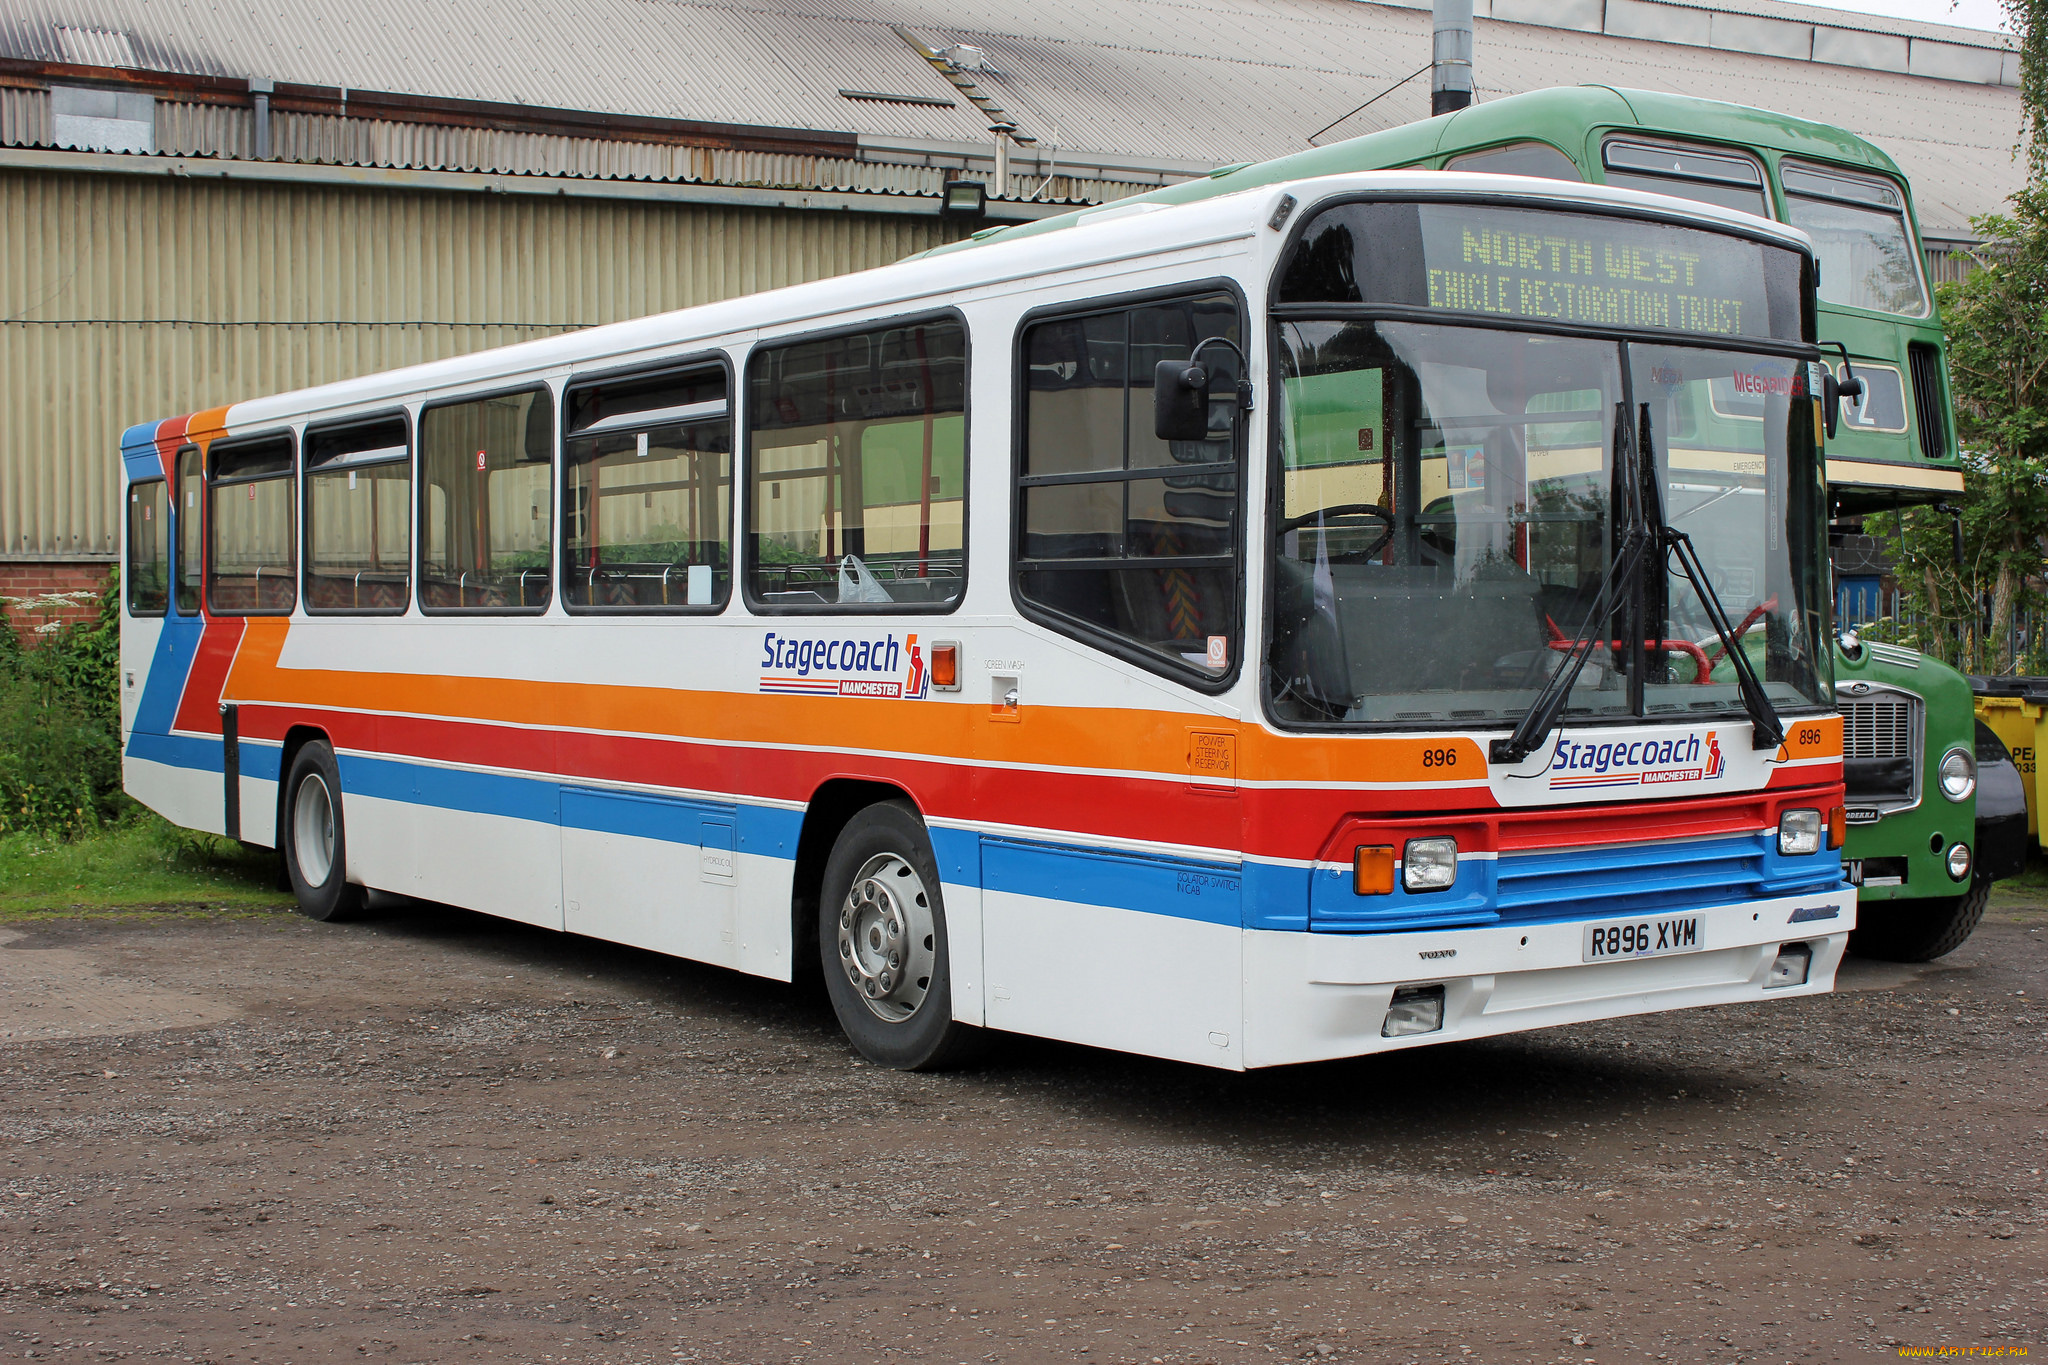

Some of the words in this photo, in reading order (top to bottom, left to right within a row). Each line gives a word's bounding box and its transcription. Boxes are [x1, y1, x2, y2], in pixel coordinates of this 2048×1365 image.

[1463, 226, 1592, 275] NORTH
[1605, 243, 1700, 286] WEST
[1520, 278, 1668, 327] RESTORATION
[1677, 295, 1742, 334] TRUST
[1733, 369, 1804, 397] MEGARIDER
[761, 633, 899, 675] Stagecoach
[984, 660, 1006, 669] SCREEN
[841, 682, 899, 696] MANCHESTER
[1198, 735, 1225, 747] POWER
[1799, 729, 1821, 745] 896
[1195, 746, 1228, 760] STEERING
[1423, 748, 1456, 767] 896
[1552, 733, 1700, 773] Stagecoach
[1195, 758, 1230, 771] RESERVOIR
[1643, 769, 1700, 783] MANCHESTER
[1177, 882, 1185, 892] IN
[1185, 884, 1200, 895] CAB
[1178, 872, 1209, 886] ISOLATOR
[1211, 877, 1240, 891] SWITCH
[1592, 923, 1650, 956] R896
[1656, 918, 1697, 949] XVM
[1418, 949, 1458, 960] VOLVO
